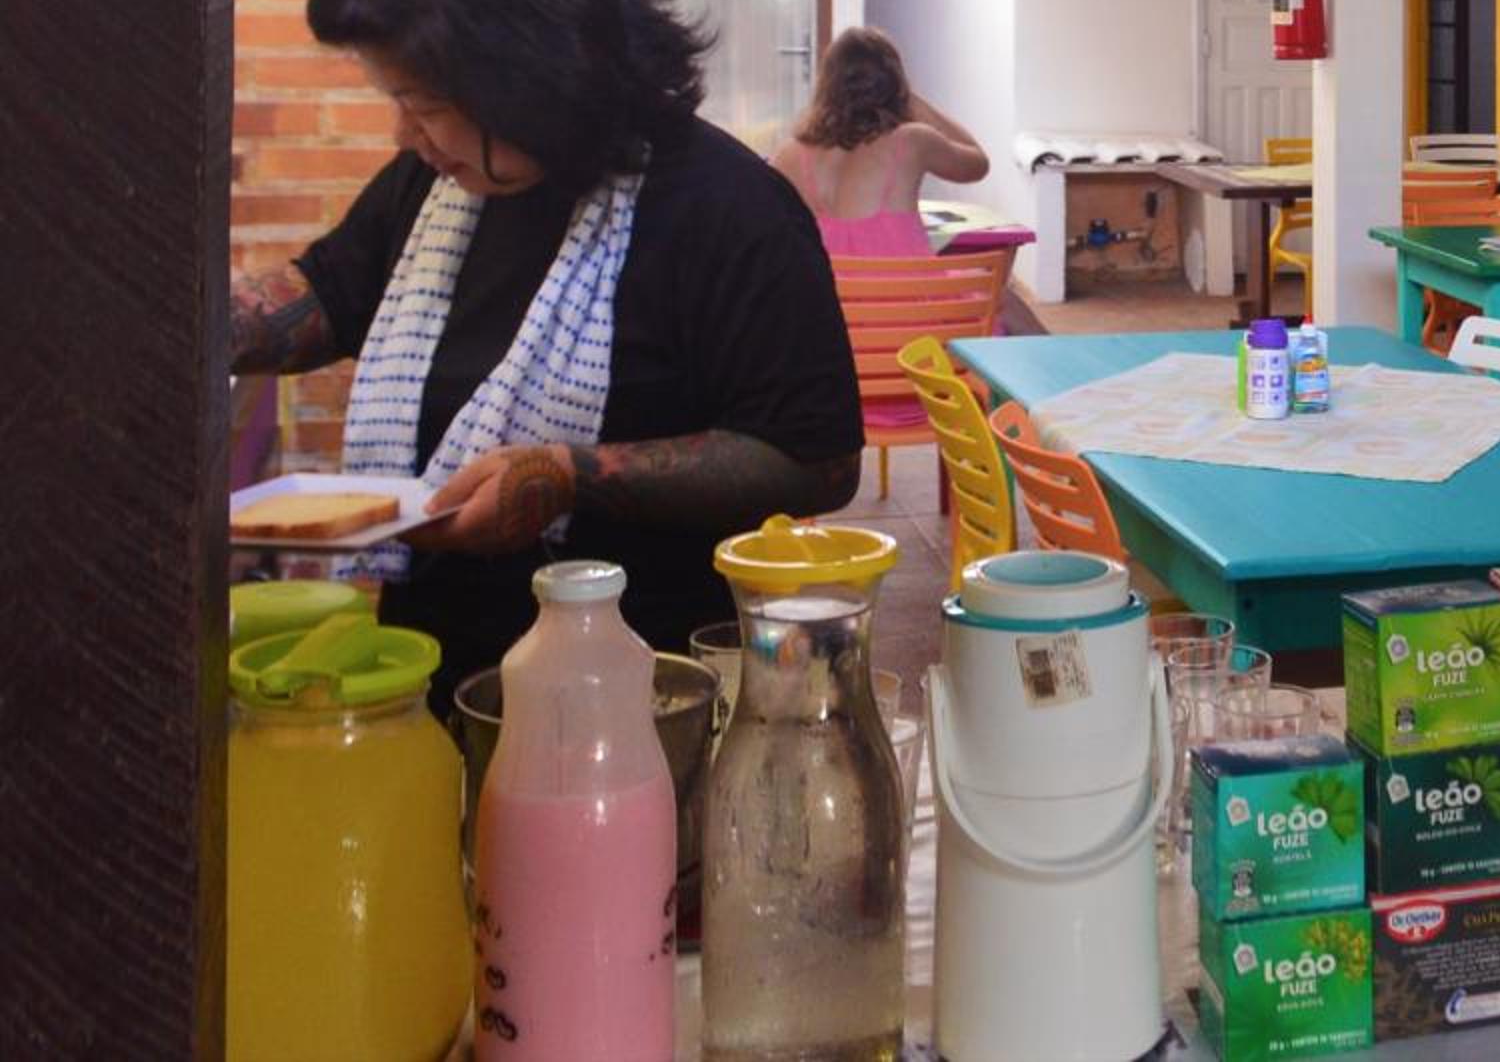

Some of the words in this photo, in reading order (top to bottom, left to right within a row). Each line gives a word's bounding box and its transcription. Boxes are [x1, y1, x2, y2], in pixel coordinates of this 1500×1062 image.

[1433, 670, 1468, 688] FUZE
[1430, 807, 1465, 826] FUZE
[1272, 833, 1310, 851] FUZE
[1280, 980, 1317, 998] FUZE
